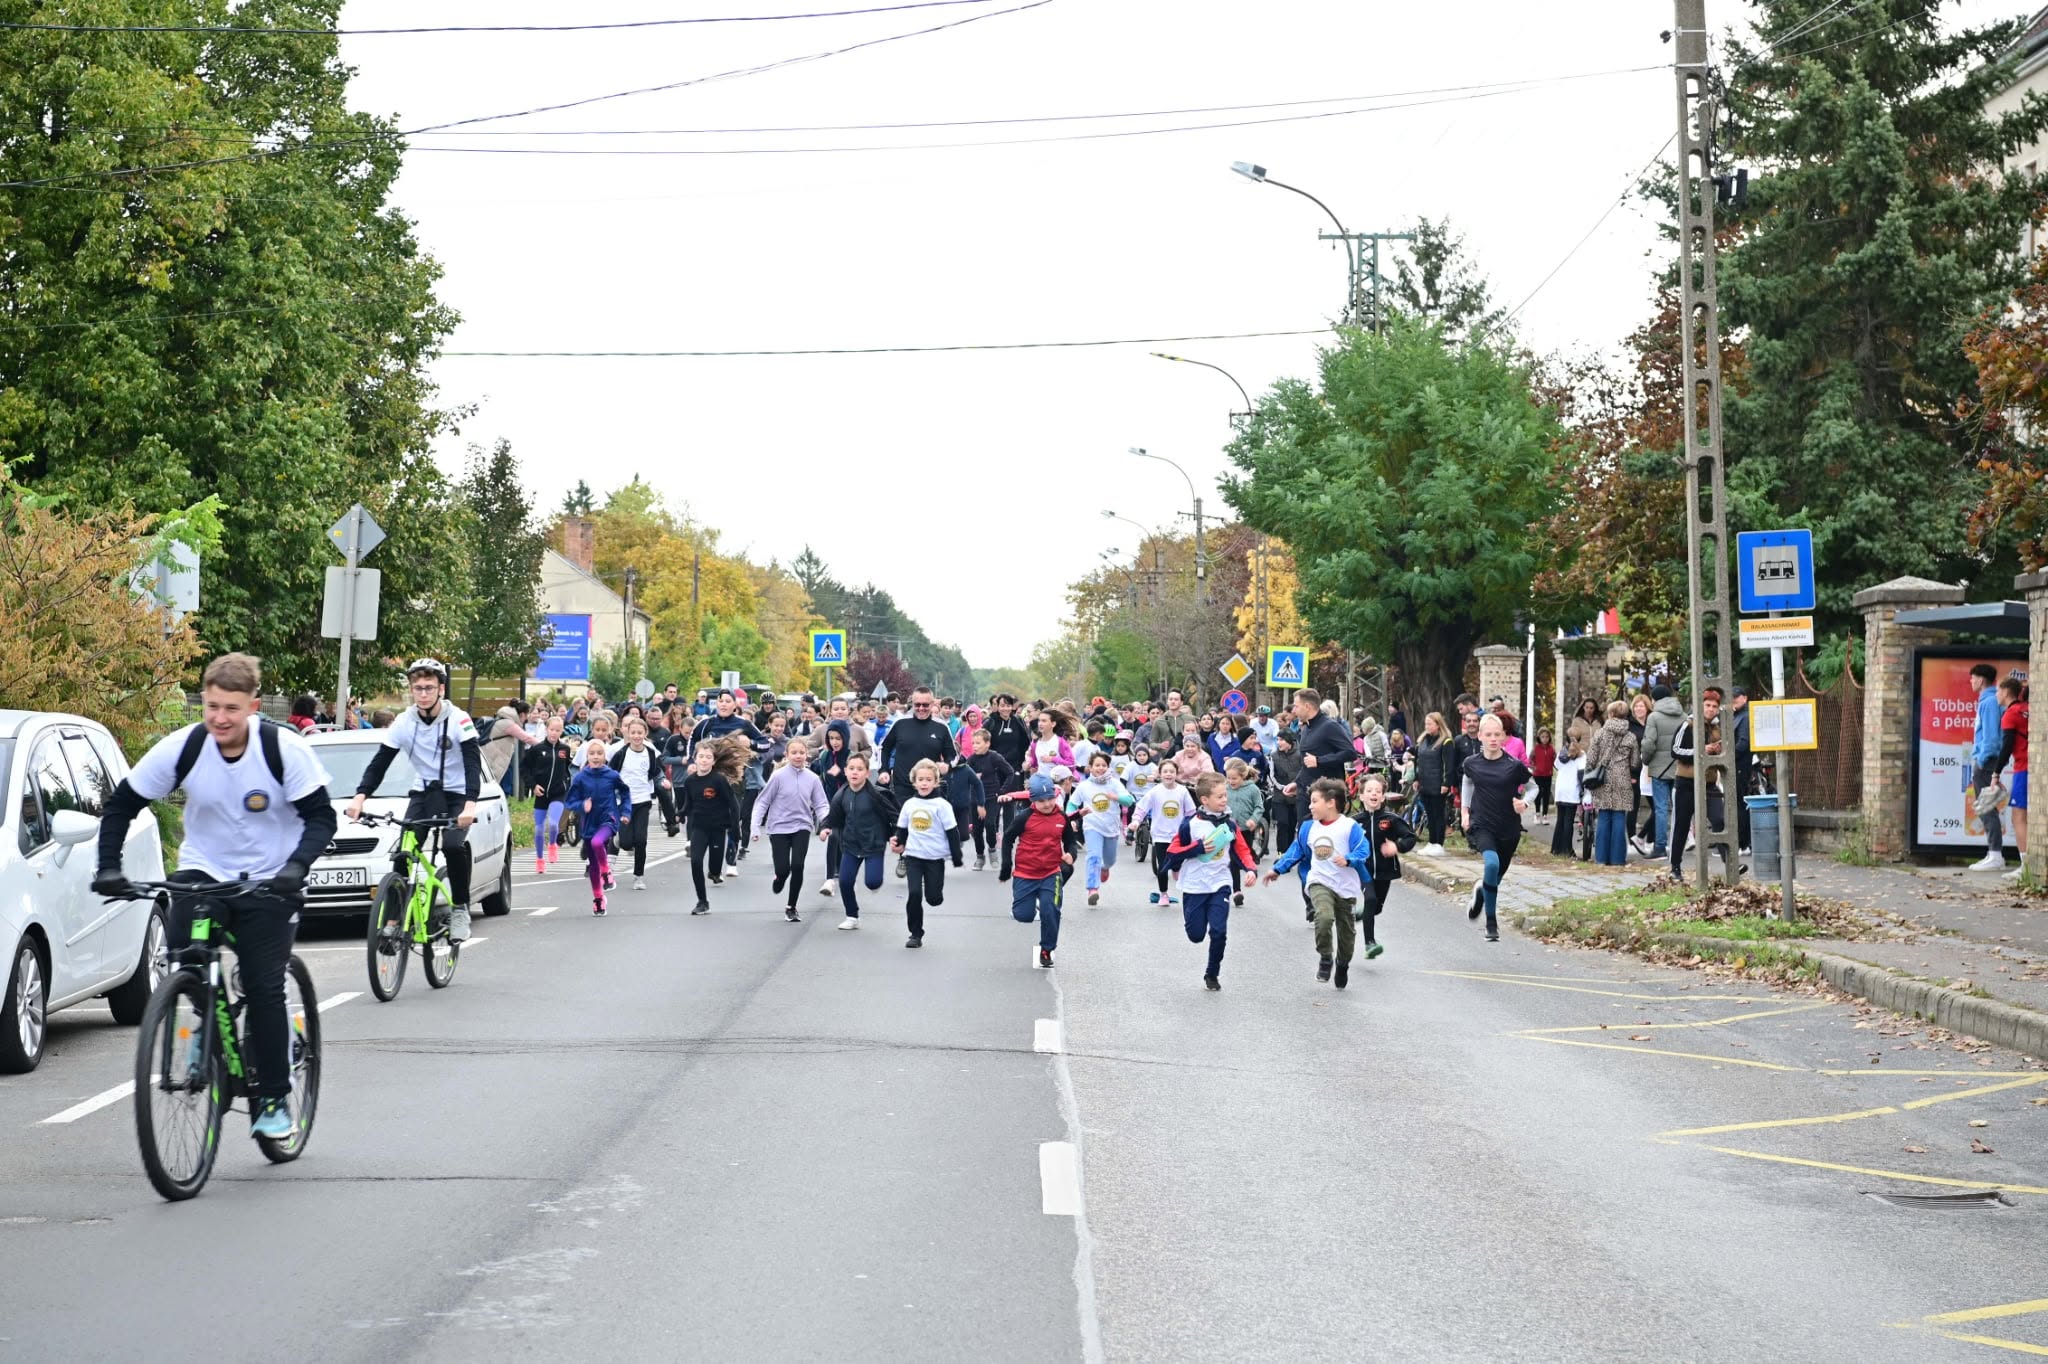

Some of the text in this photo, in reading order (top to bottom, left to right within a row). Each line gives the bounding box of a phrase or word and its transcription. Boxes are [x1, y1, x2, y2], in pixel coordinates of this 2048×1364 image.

[2009, 668, 2027, 679] dm
[1932, 698, 1978, 712] Többet
[1932, 717, 1940, 727] a
